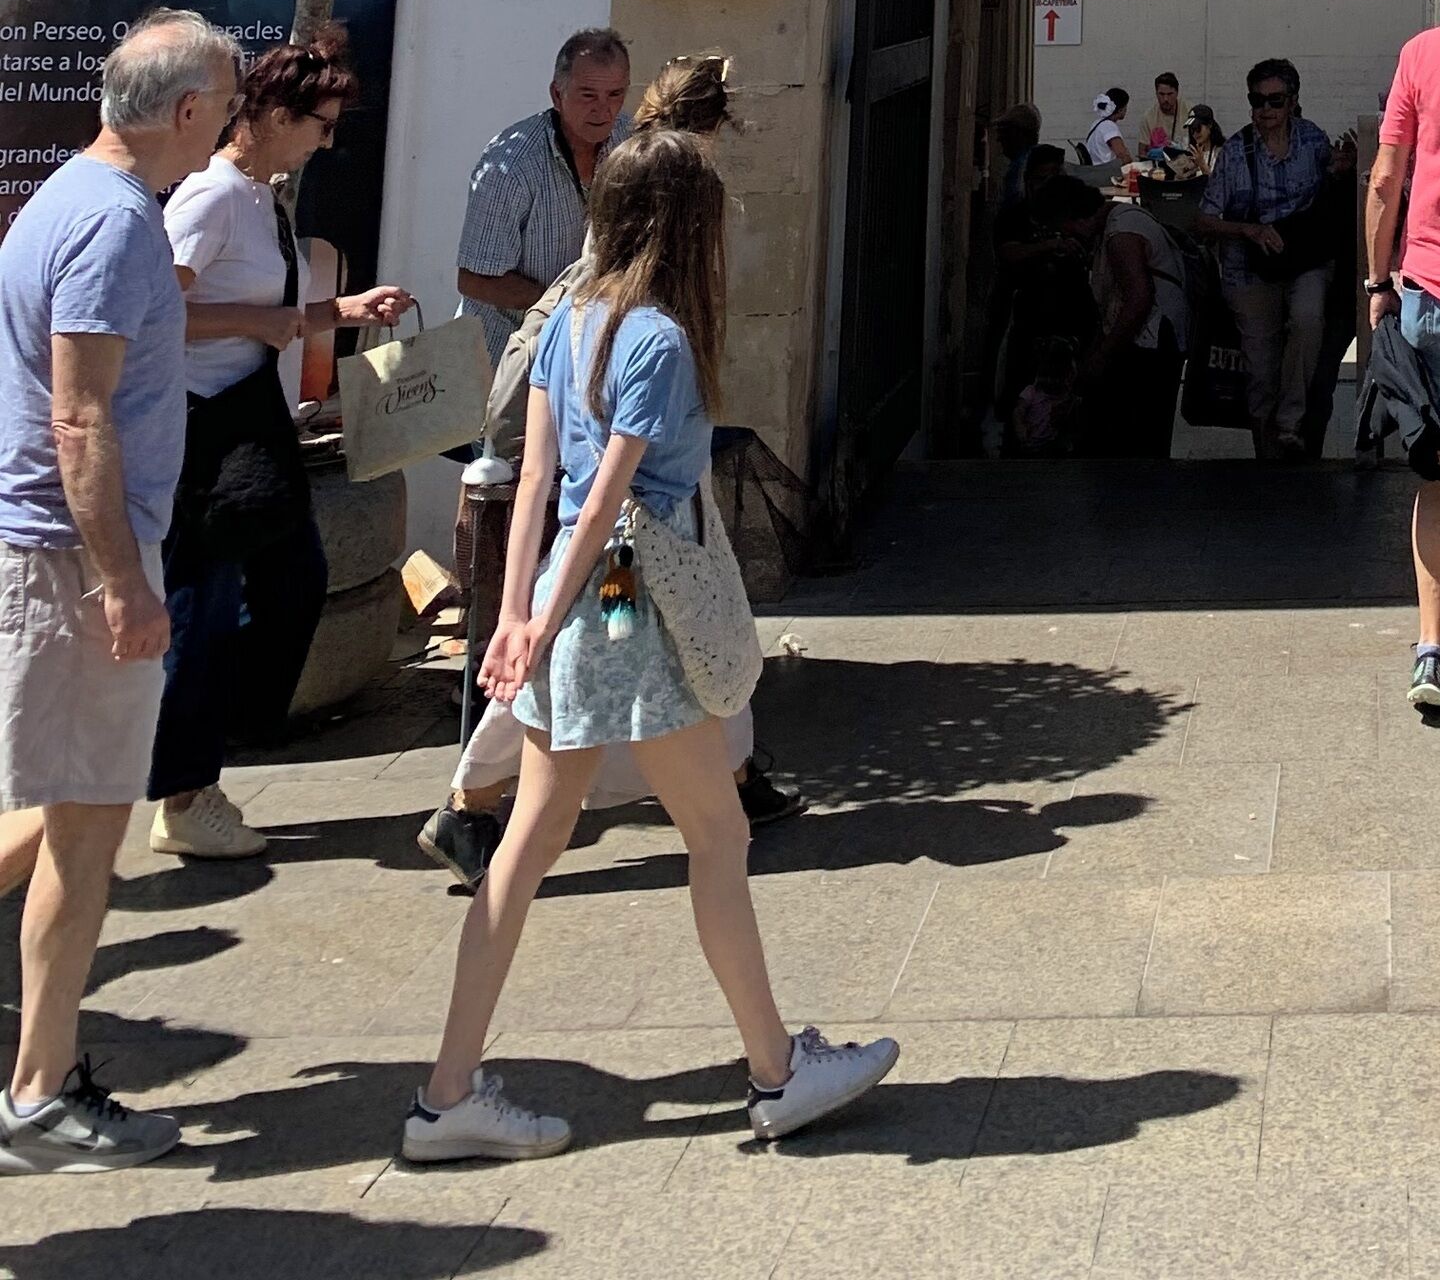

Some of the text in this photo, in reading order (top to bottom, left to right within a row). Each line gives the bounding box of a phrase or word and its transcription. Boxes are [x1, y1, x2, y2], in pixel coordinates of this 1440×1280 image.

[33, 21, 106, 43] Perseo,
[0, 53, 53, 71] tarse
[59, 56, 70, 70] a
[28, 81, 103, 101] Mundo
